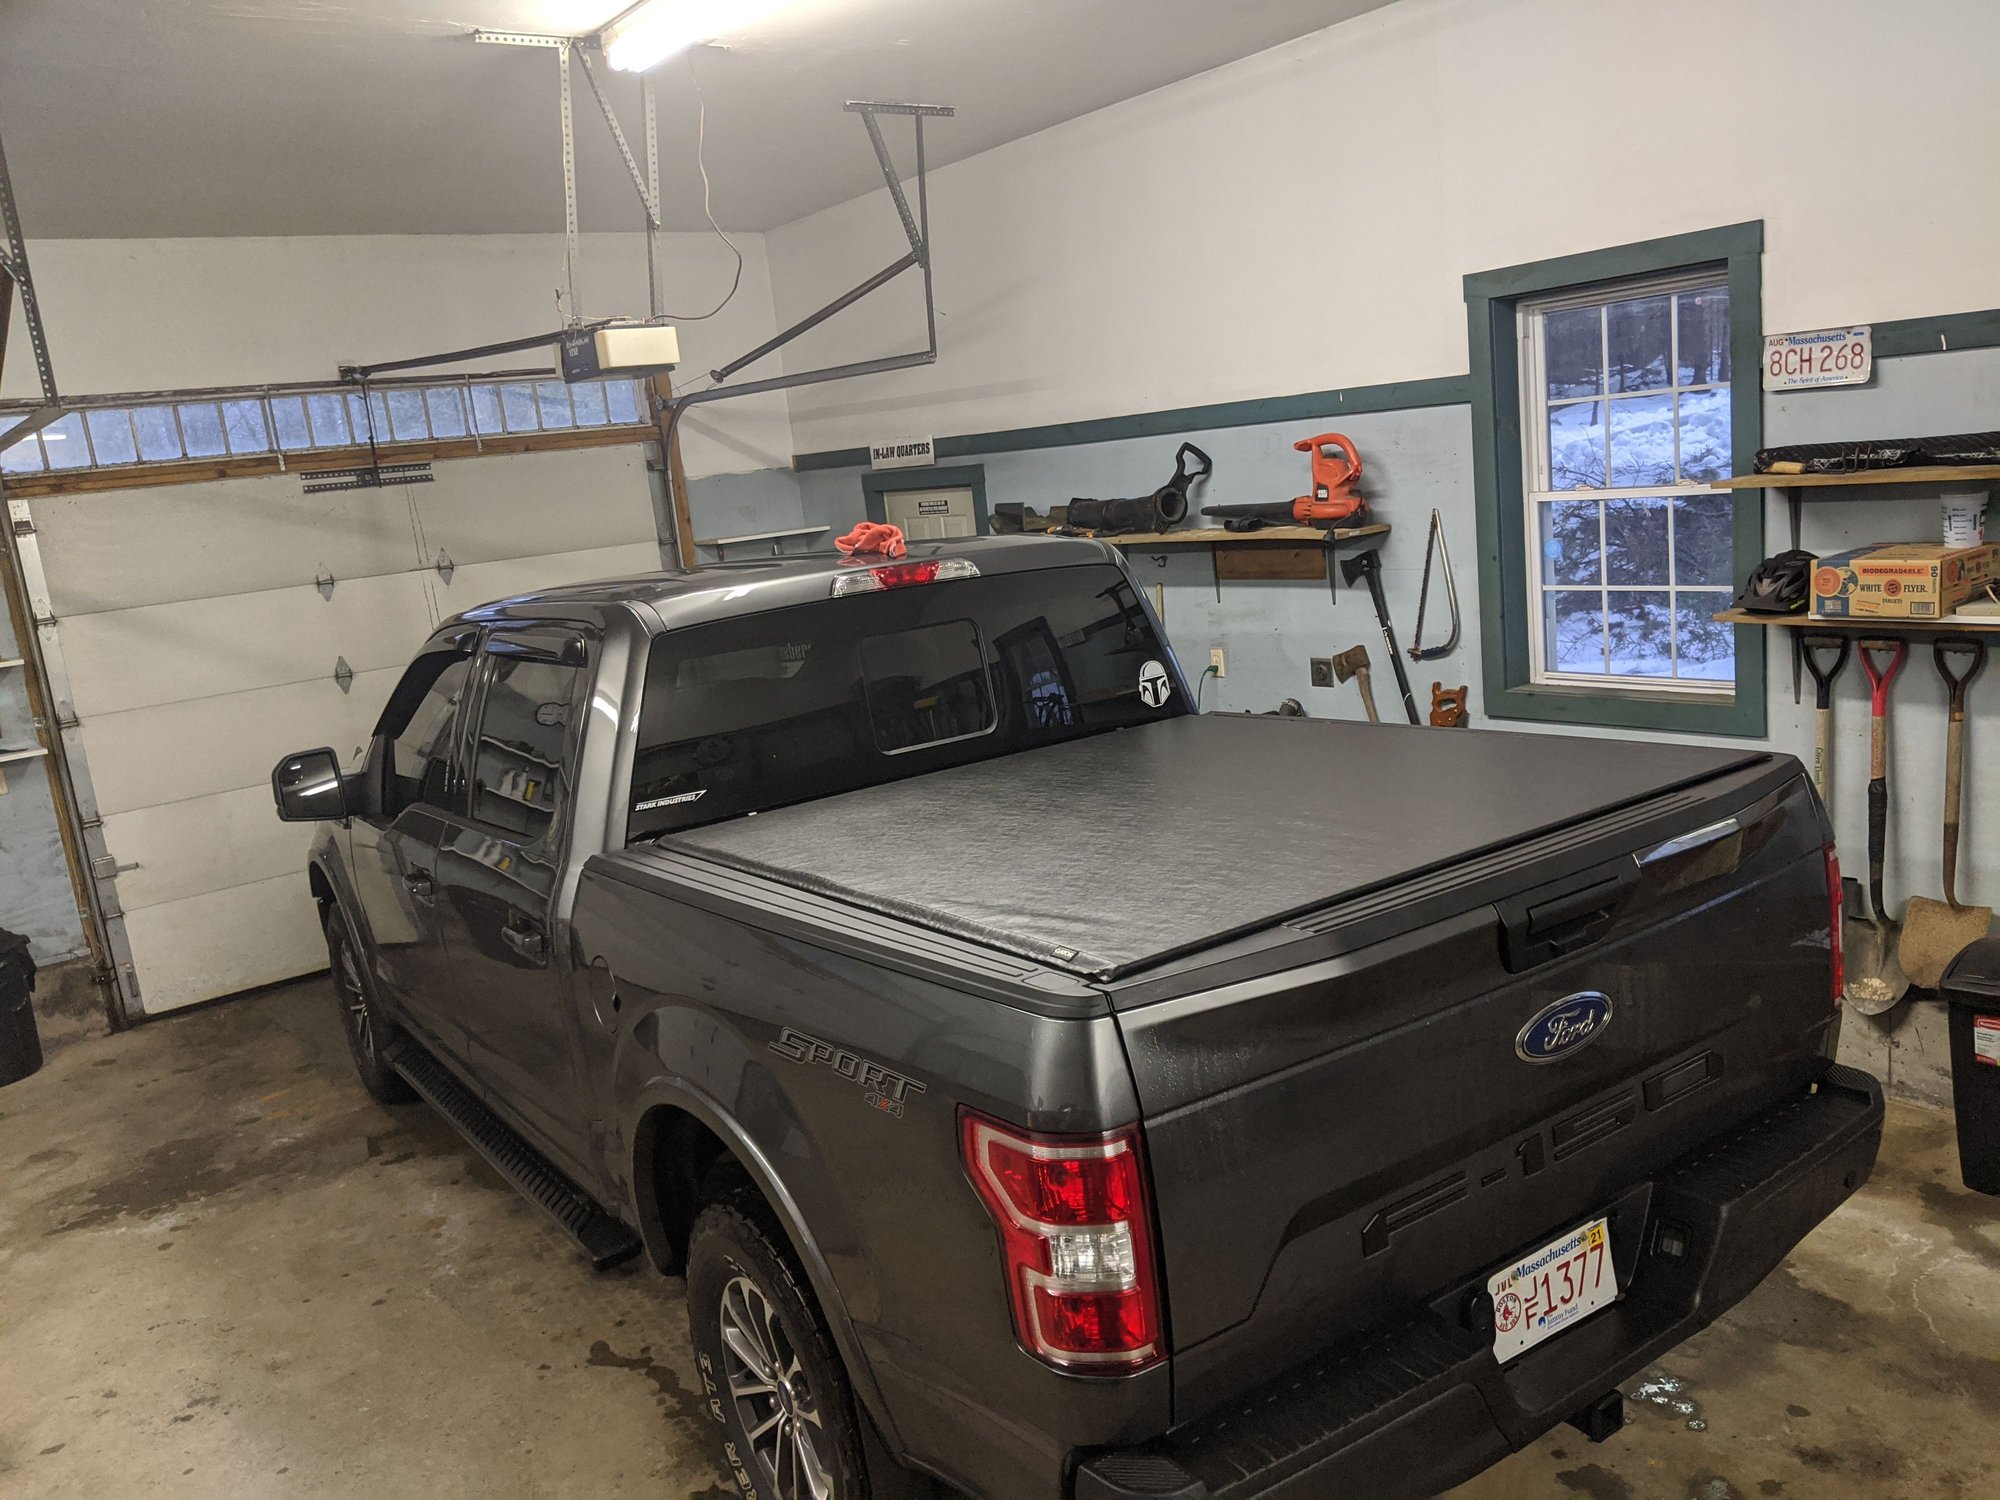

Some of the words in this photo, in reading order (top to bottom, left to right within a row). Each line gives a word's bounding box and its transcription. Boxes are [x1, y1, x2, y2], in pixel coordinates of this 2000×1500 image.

[1768, 338, 1784, 347] AUG
[1788, 332, 1847, 346] Massachusetts
[1770, 346, 1813, 376] 8CH
[1820, 342, 1864, 373] 268
[1799, 376, 1814, 384] Spirit
[873, 446, 896, 460] IN-LAW
[896, 442, 931, 458] QUARTERS
[1859, 583, 1882, 593] WHITE
[635, 801, 657, 812] STARK
[657, 794, 696, 807] INDUSTRIES
[1543, 1007, 1595, 1051] Ford
[768, 1027, 927, 1103] SPORT
[1495, 1278, 1513, 1296] JUL
[1515, 1236, 1582, 1279] Massachusetts
[1590, 1229, 1602, 1244] 21
[1497, 1295, 1517, 1313] BOSTON
